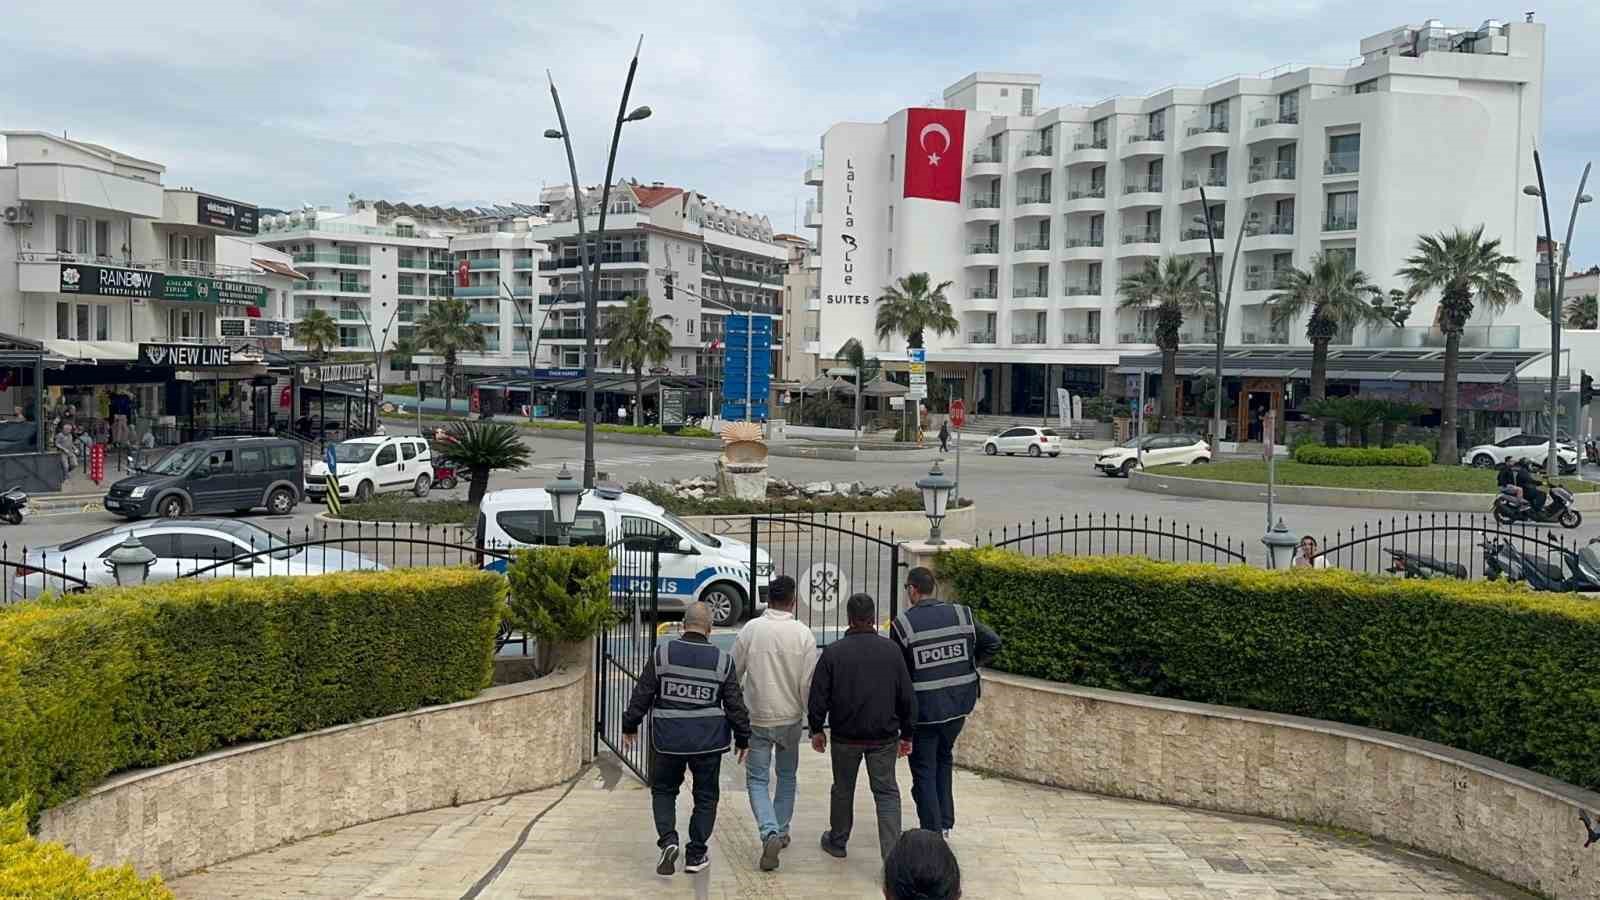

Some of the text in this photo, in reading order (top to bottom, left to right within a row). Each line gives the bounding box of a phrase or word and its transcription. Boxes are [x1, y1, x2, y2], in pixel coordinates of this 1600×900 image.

[100, 269, 152, 288] RAINBOW
[827, 294, 870, 304] SUITES
[168, 347, 229, 365] NEW LINE
[487, 539, 502, 548] 12
